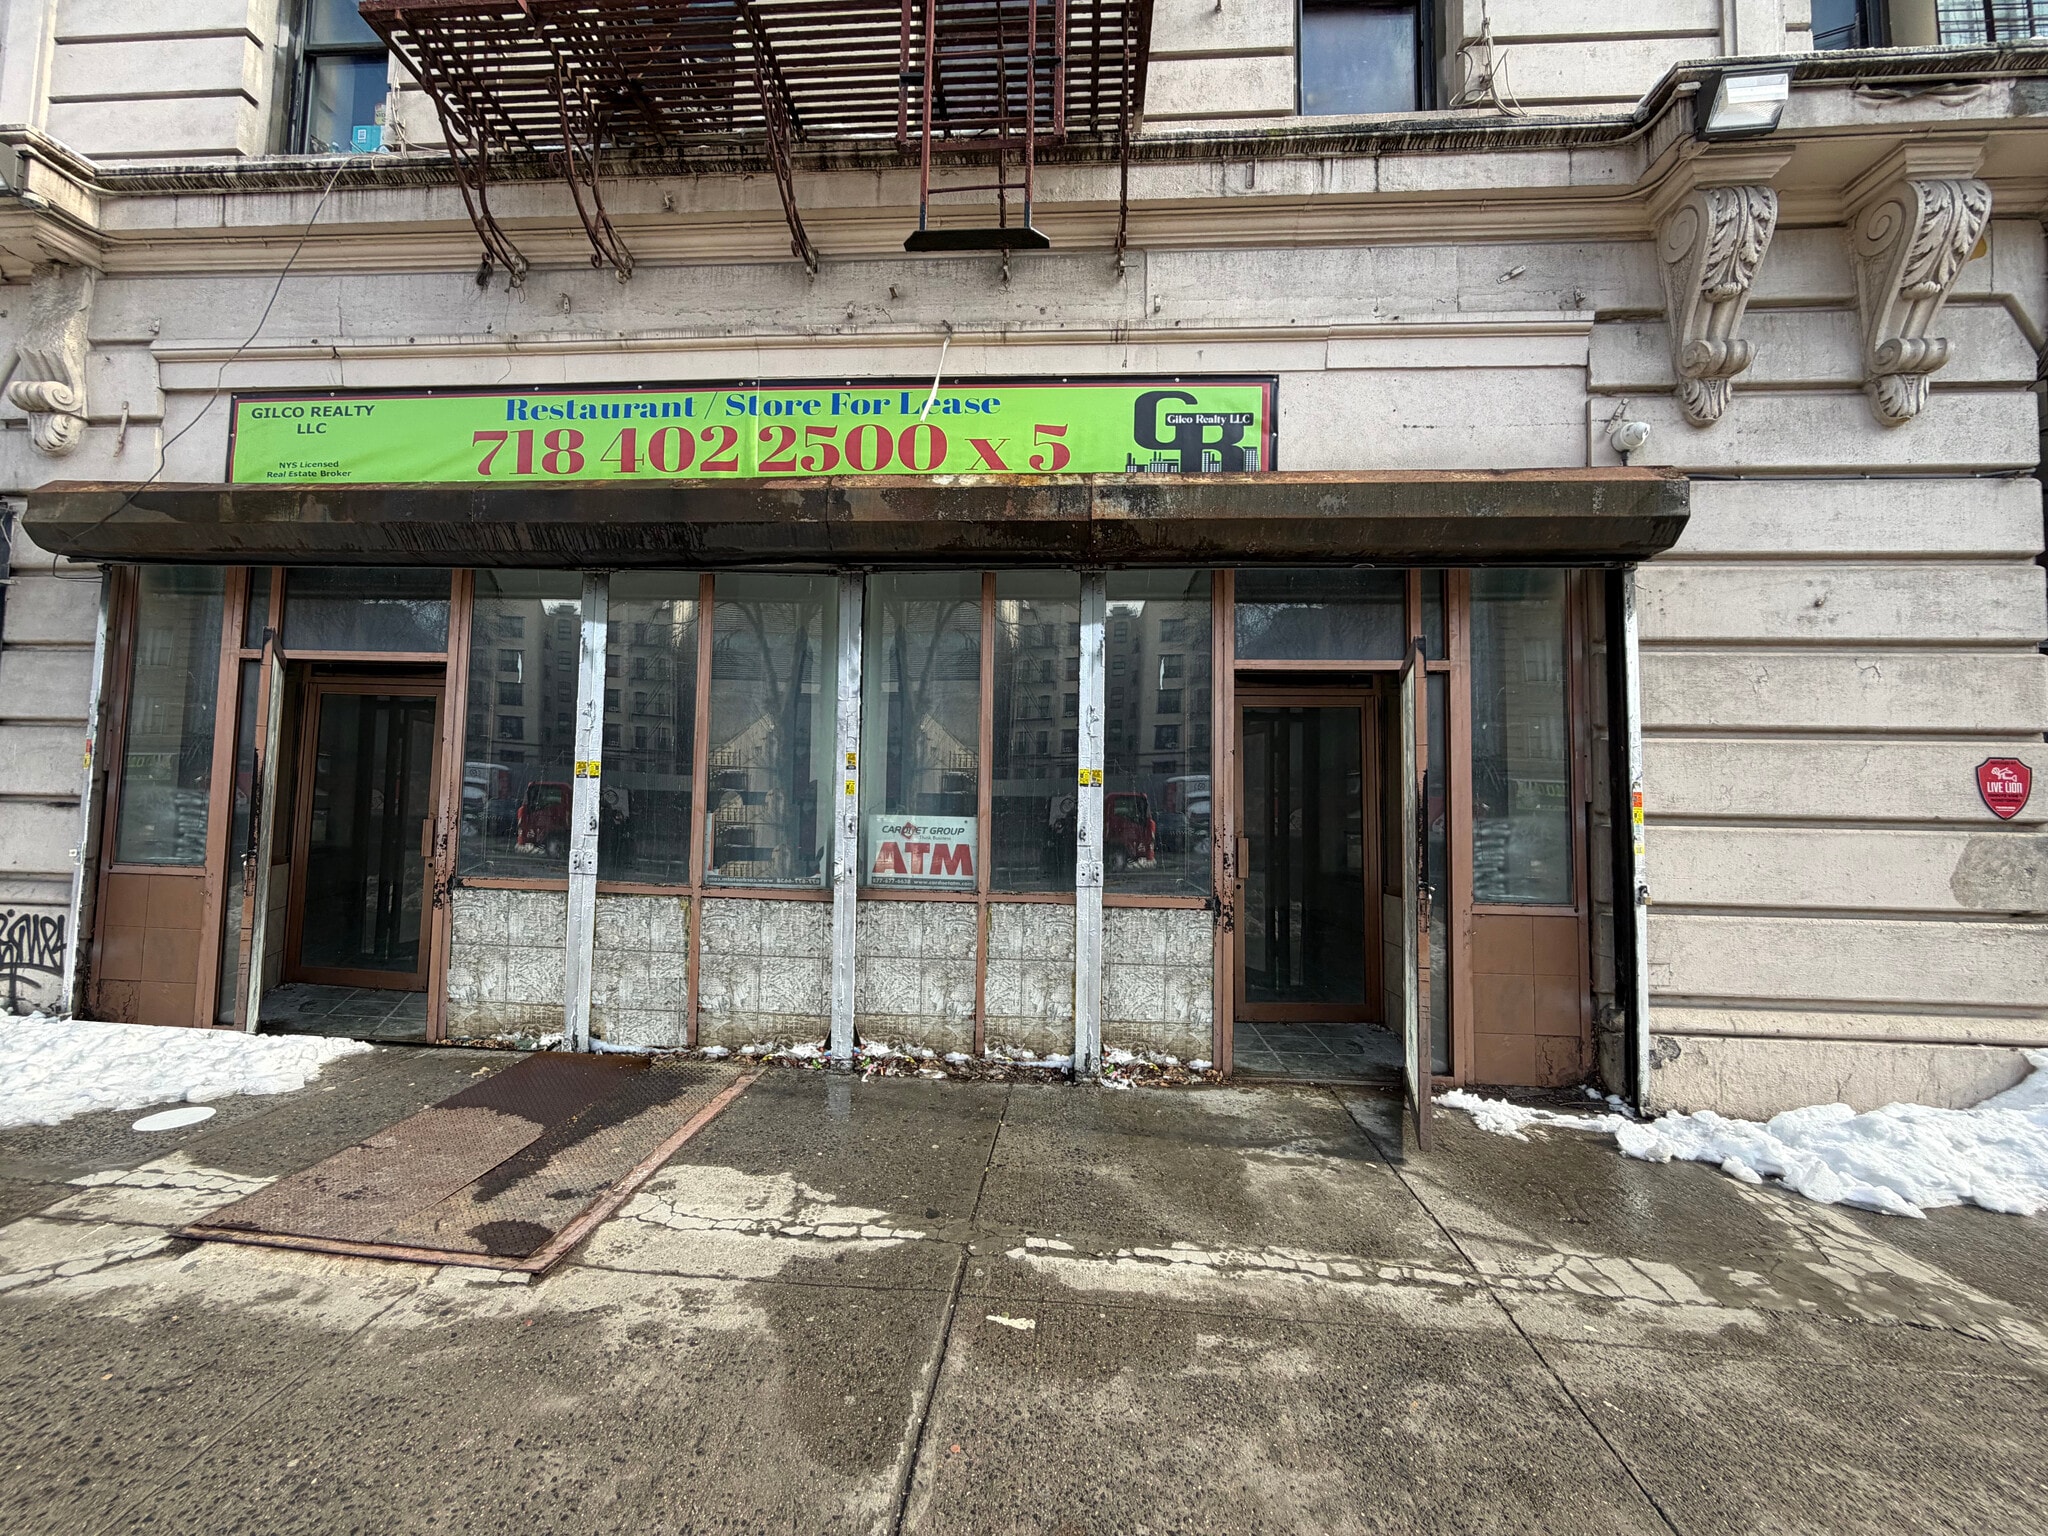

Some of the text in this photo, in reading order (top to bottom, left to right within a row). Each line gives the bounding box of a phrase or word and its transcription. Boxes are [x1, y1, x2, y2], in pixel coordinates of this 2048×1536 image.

[251, 404, 376, 419] GILCO REALTY
[505, 391, 1001, 421] Restaurant / Store For Lease
[1166, 414, 1250, 426] Gilco Realty LLC
[296, 422, 327, 435] LLC
[471, 423, 1072, 476] 718 402 2500 x 5
[279, 460, 339, 469] NYS Licensed
[266, 470, 286, 478] Real
[320, 469, 352, 477] Broker
[1986, 781, 2003, 793] LIVE
[929, 827, 965, 836] GROUP
[872, 841, 974, 876] ATM
